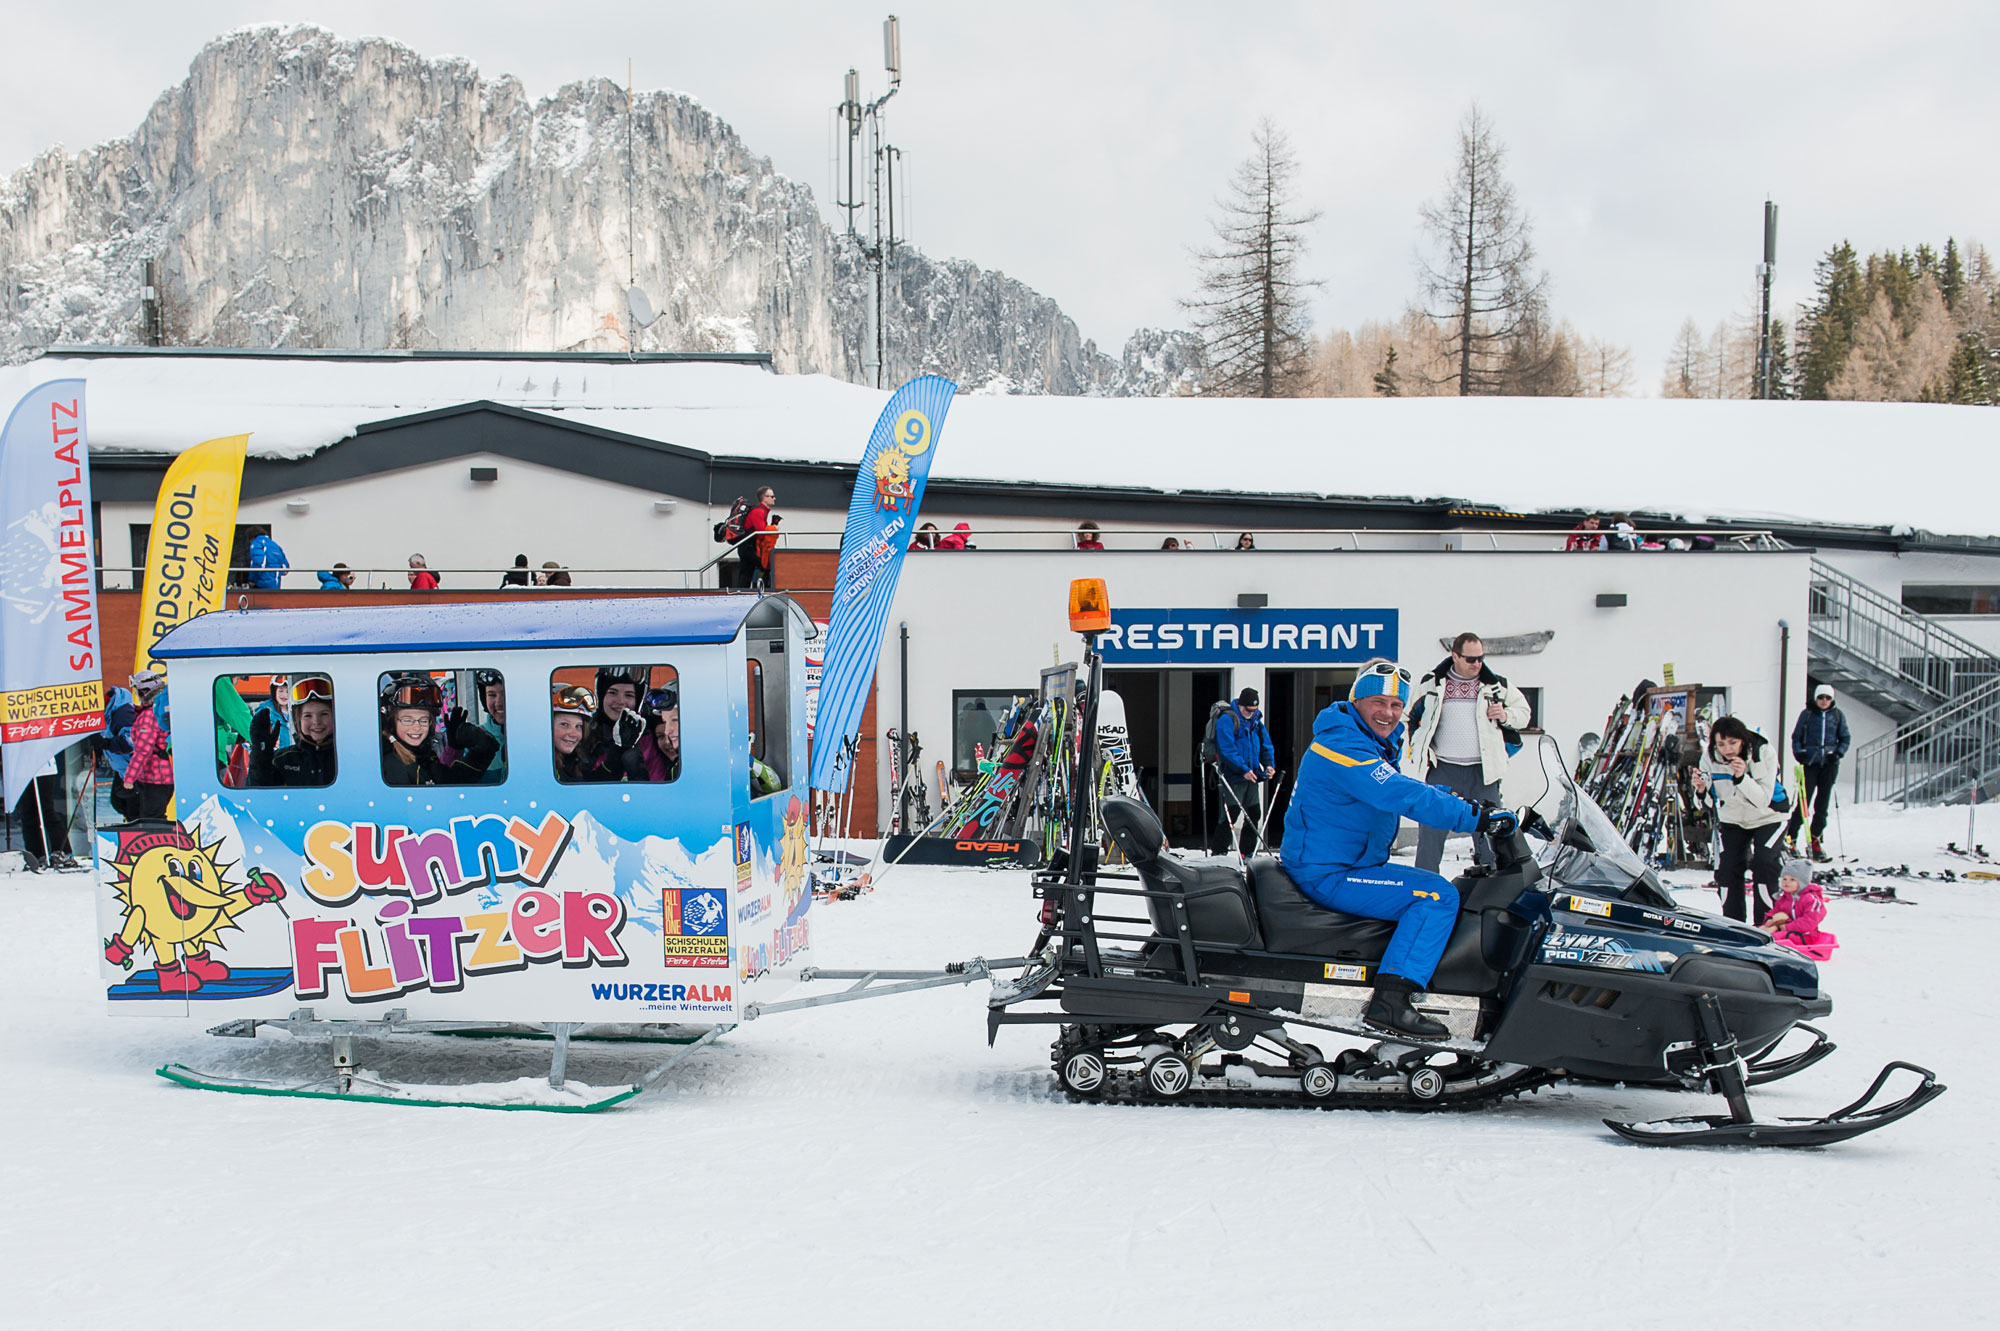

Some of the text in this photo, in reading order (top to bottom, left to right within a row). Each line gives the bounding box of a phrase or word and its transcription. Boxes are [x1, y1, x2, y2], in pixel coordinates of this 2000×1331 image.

[903, 417, 925, 446] 9
[51, 398, 94, 671] SAMMELPLATZ
[845, 516, 906, 573] FAMILIEN
[147, 484, 197, 677] ORDSCHOOL
[1097, 623, 1384, 649] RESTAURANT
[7, 684, 98, 707] SCHISCHULEN
[8, 698, 100, 721] WURZERALM
[8, 725, 43, 737] Peter
[62, 714, 102, 731] Stefan
[1097, 725, 1126, 734] HEAD
[955, 841, 1020, 853] HEAD
[301, 810, 572, 907] Sunny
[664, 890, 679, 906] ALL
[1643, 912, 1663, 921] ROTAX
[665, 920, 681, 935] ONE
[666, 938, 726, 946] SCHISCHULEN
[666, 946, 727, 954] WURZERALM
[1546, 932, 1616, 950] LYNX
[666, 957, 690, 965] Peter
[700, 956, 728, 966] Stefan
[1545, 950, 1634, 967] PRO YETI
[591, 983, 732, 1002] WURZERALM
[680, 1003, 733, 1012] Winterwelt
